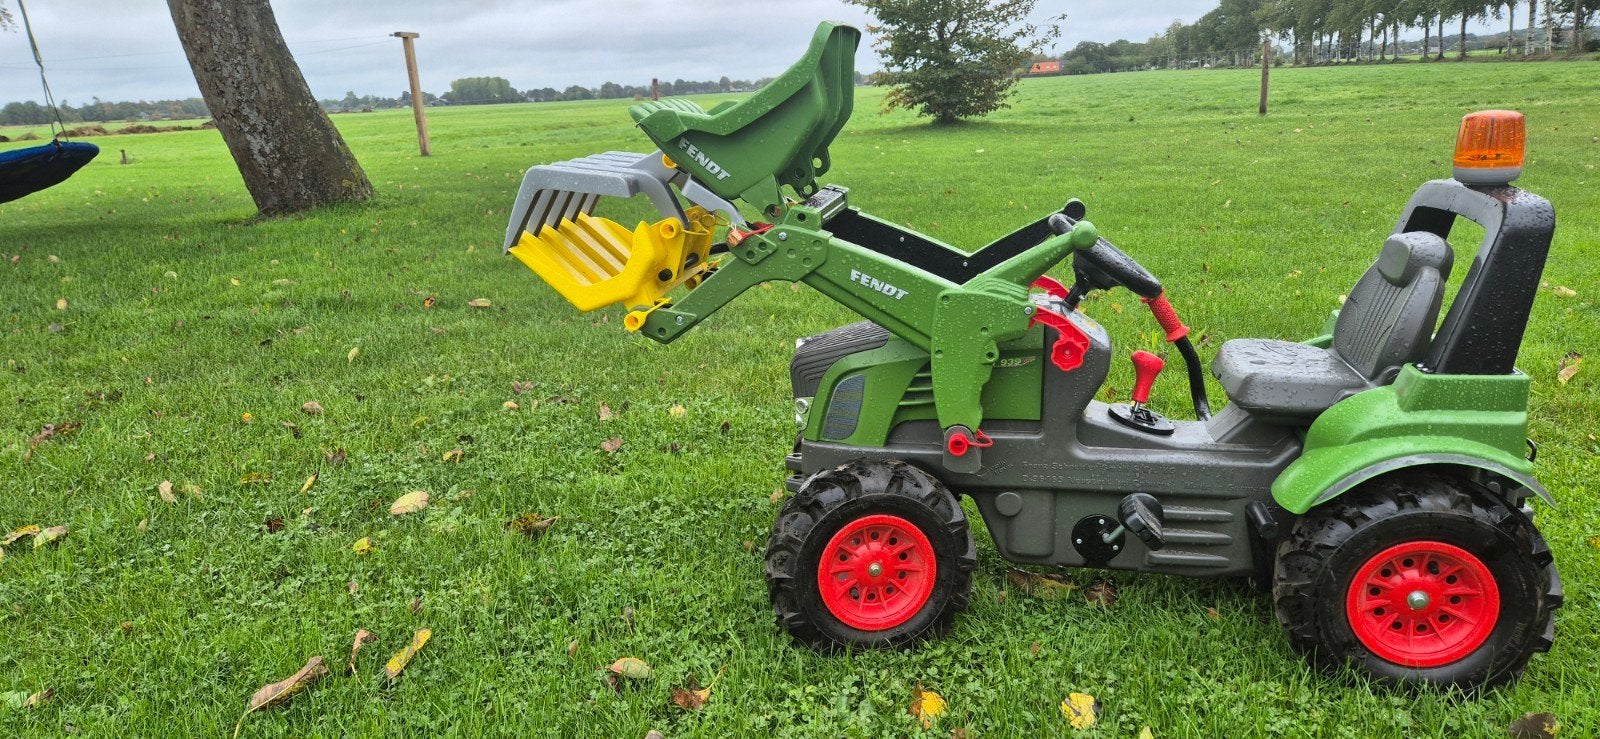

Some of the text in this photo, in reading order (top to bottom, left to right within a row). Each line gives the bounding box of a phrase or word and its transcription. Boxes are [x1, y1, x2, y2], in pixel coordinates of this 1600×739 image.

[679, 137, 731, 180] FENDT
[851, 269, 909, 300] FENDT
[1001, 358, 1021, 366] 939
